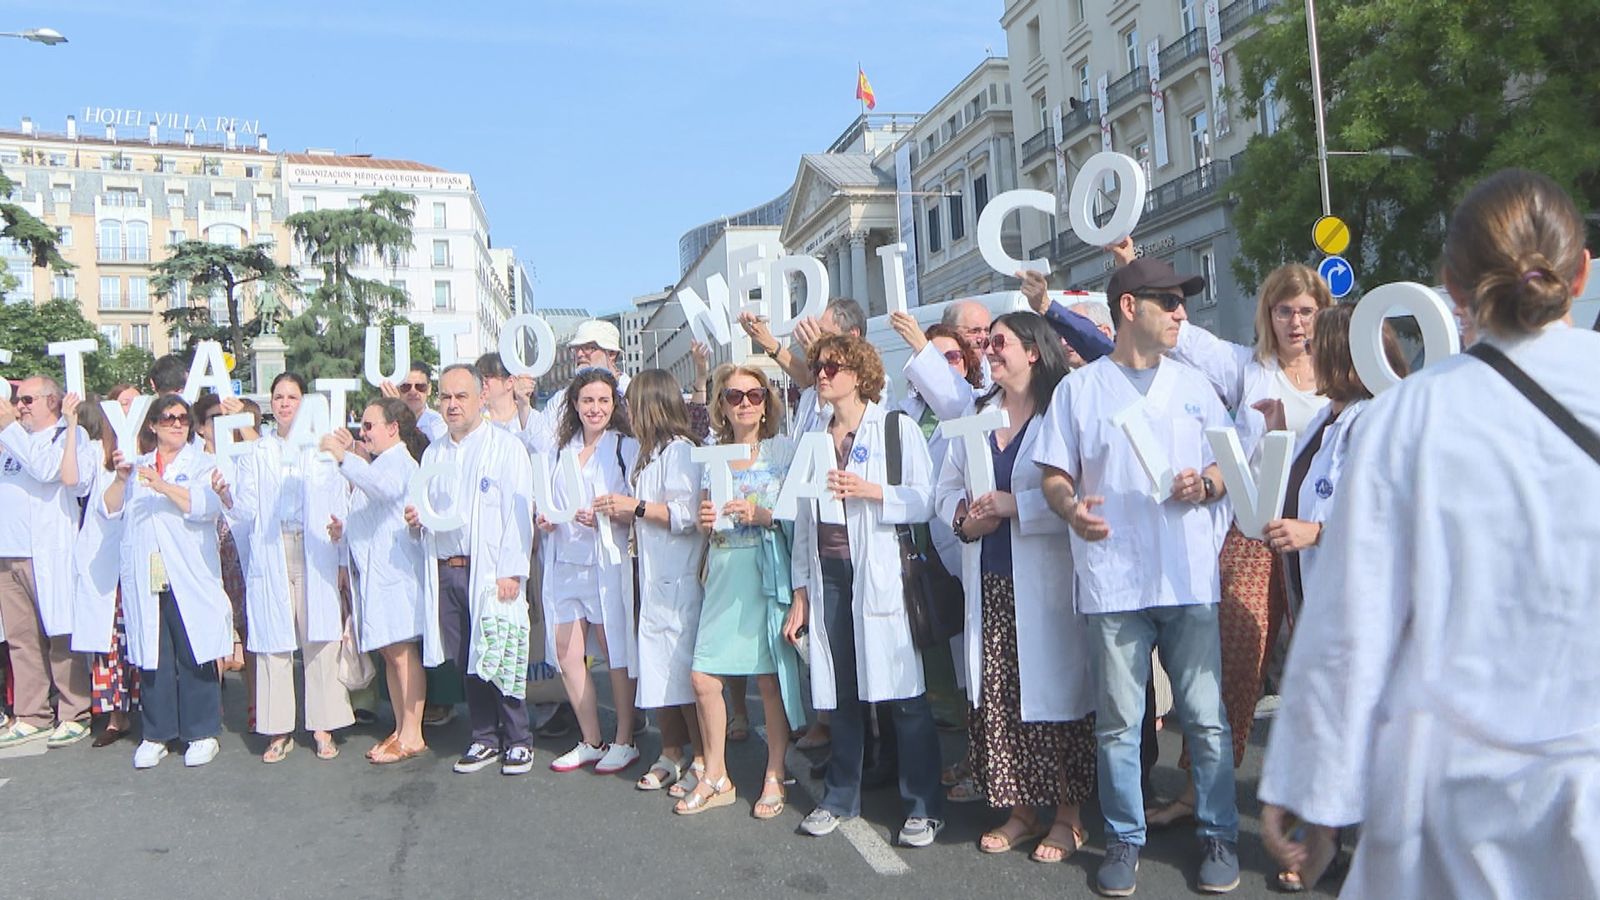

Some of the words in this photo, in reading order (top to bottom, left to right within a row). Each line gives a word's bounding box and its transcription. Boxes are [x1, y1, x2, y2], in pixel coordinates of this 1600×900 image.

[85, 106, 142, 126] HOTEL
[154, 111, 207, 131] VILLA
[294, 168, 351, 179] ORGANIZACIÓN
[354, 170, 384, 182] MÉDICA
[384, 173, 421, 183] COLEGIAL
[423, 175, 433, 184] DE
[435, 175, 463, 186] ESPAÑA
